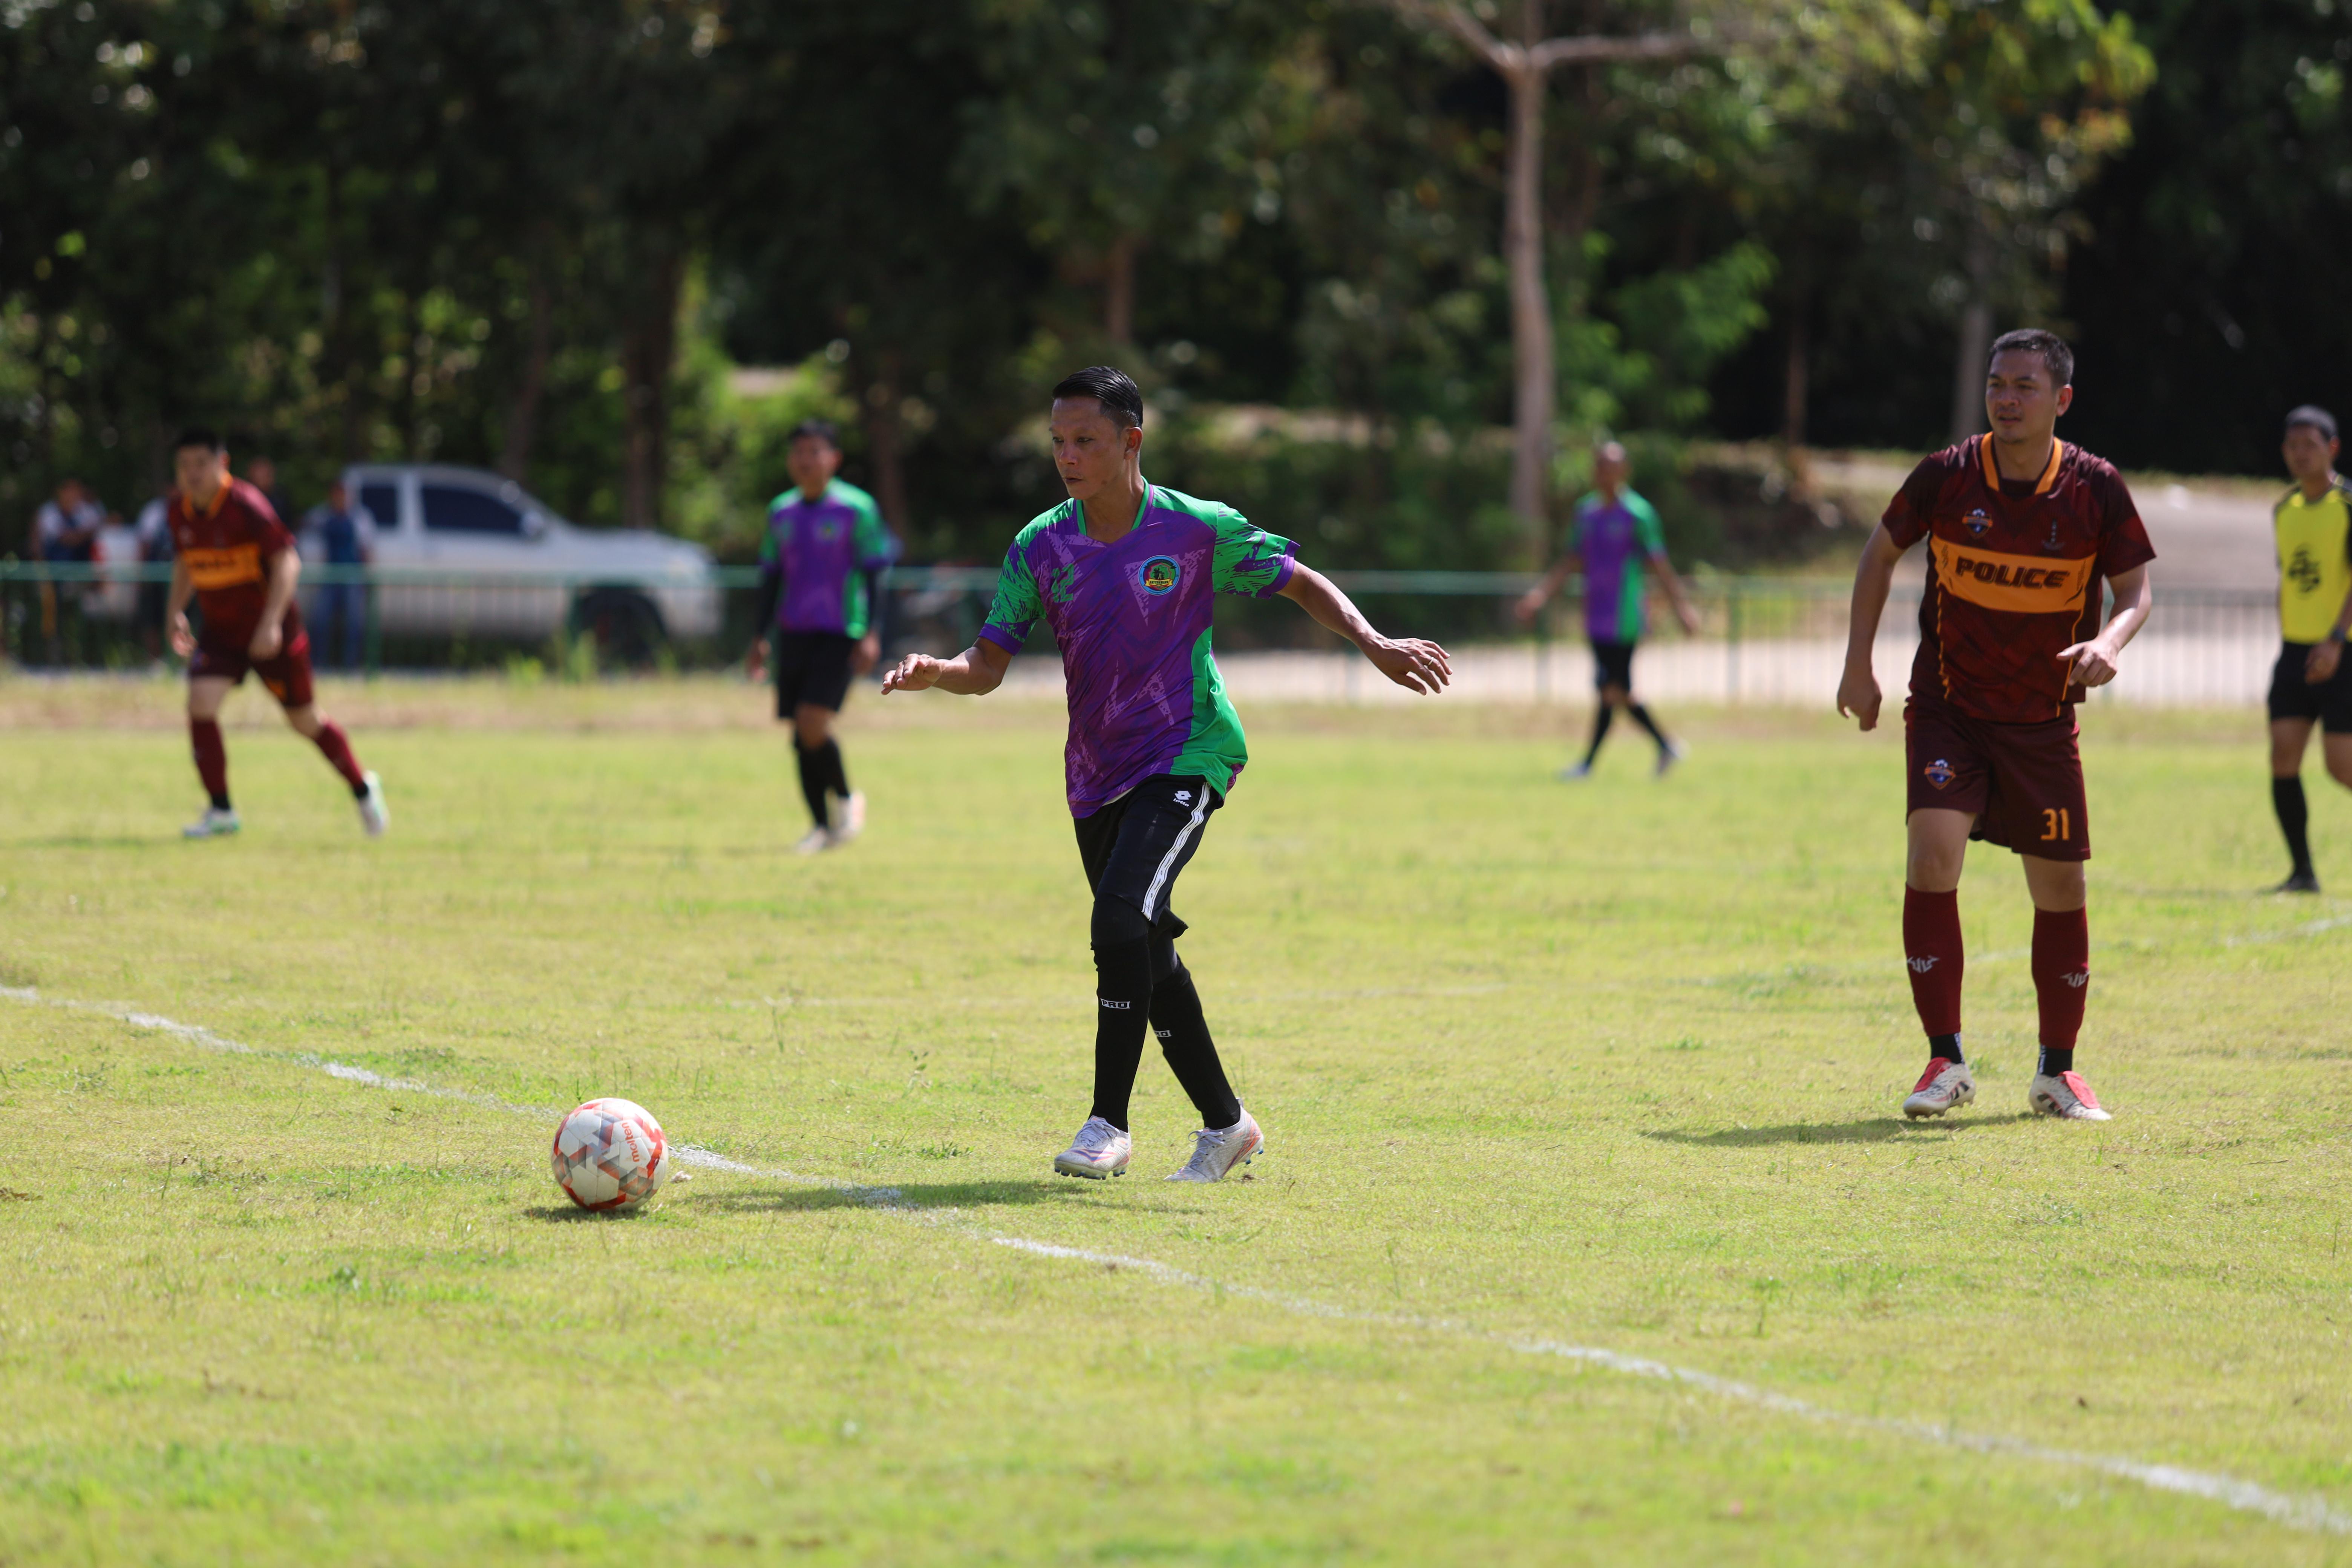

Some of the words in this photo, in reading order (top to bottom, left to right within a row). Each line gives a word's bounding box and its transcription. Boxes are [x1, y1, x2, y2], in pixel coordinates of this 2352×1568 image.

[1955, 556, 2070, 589] POLICE
[2040, 808, 2069, 840] 31
[1101, 999, 1128, 1008] PRO
[621, 1122, 640, 1162] molten
